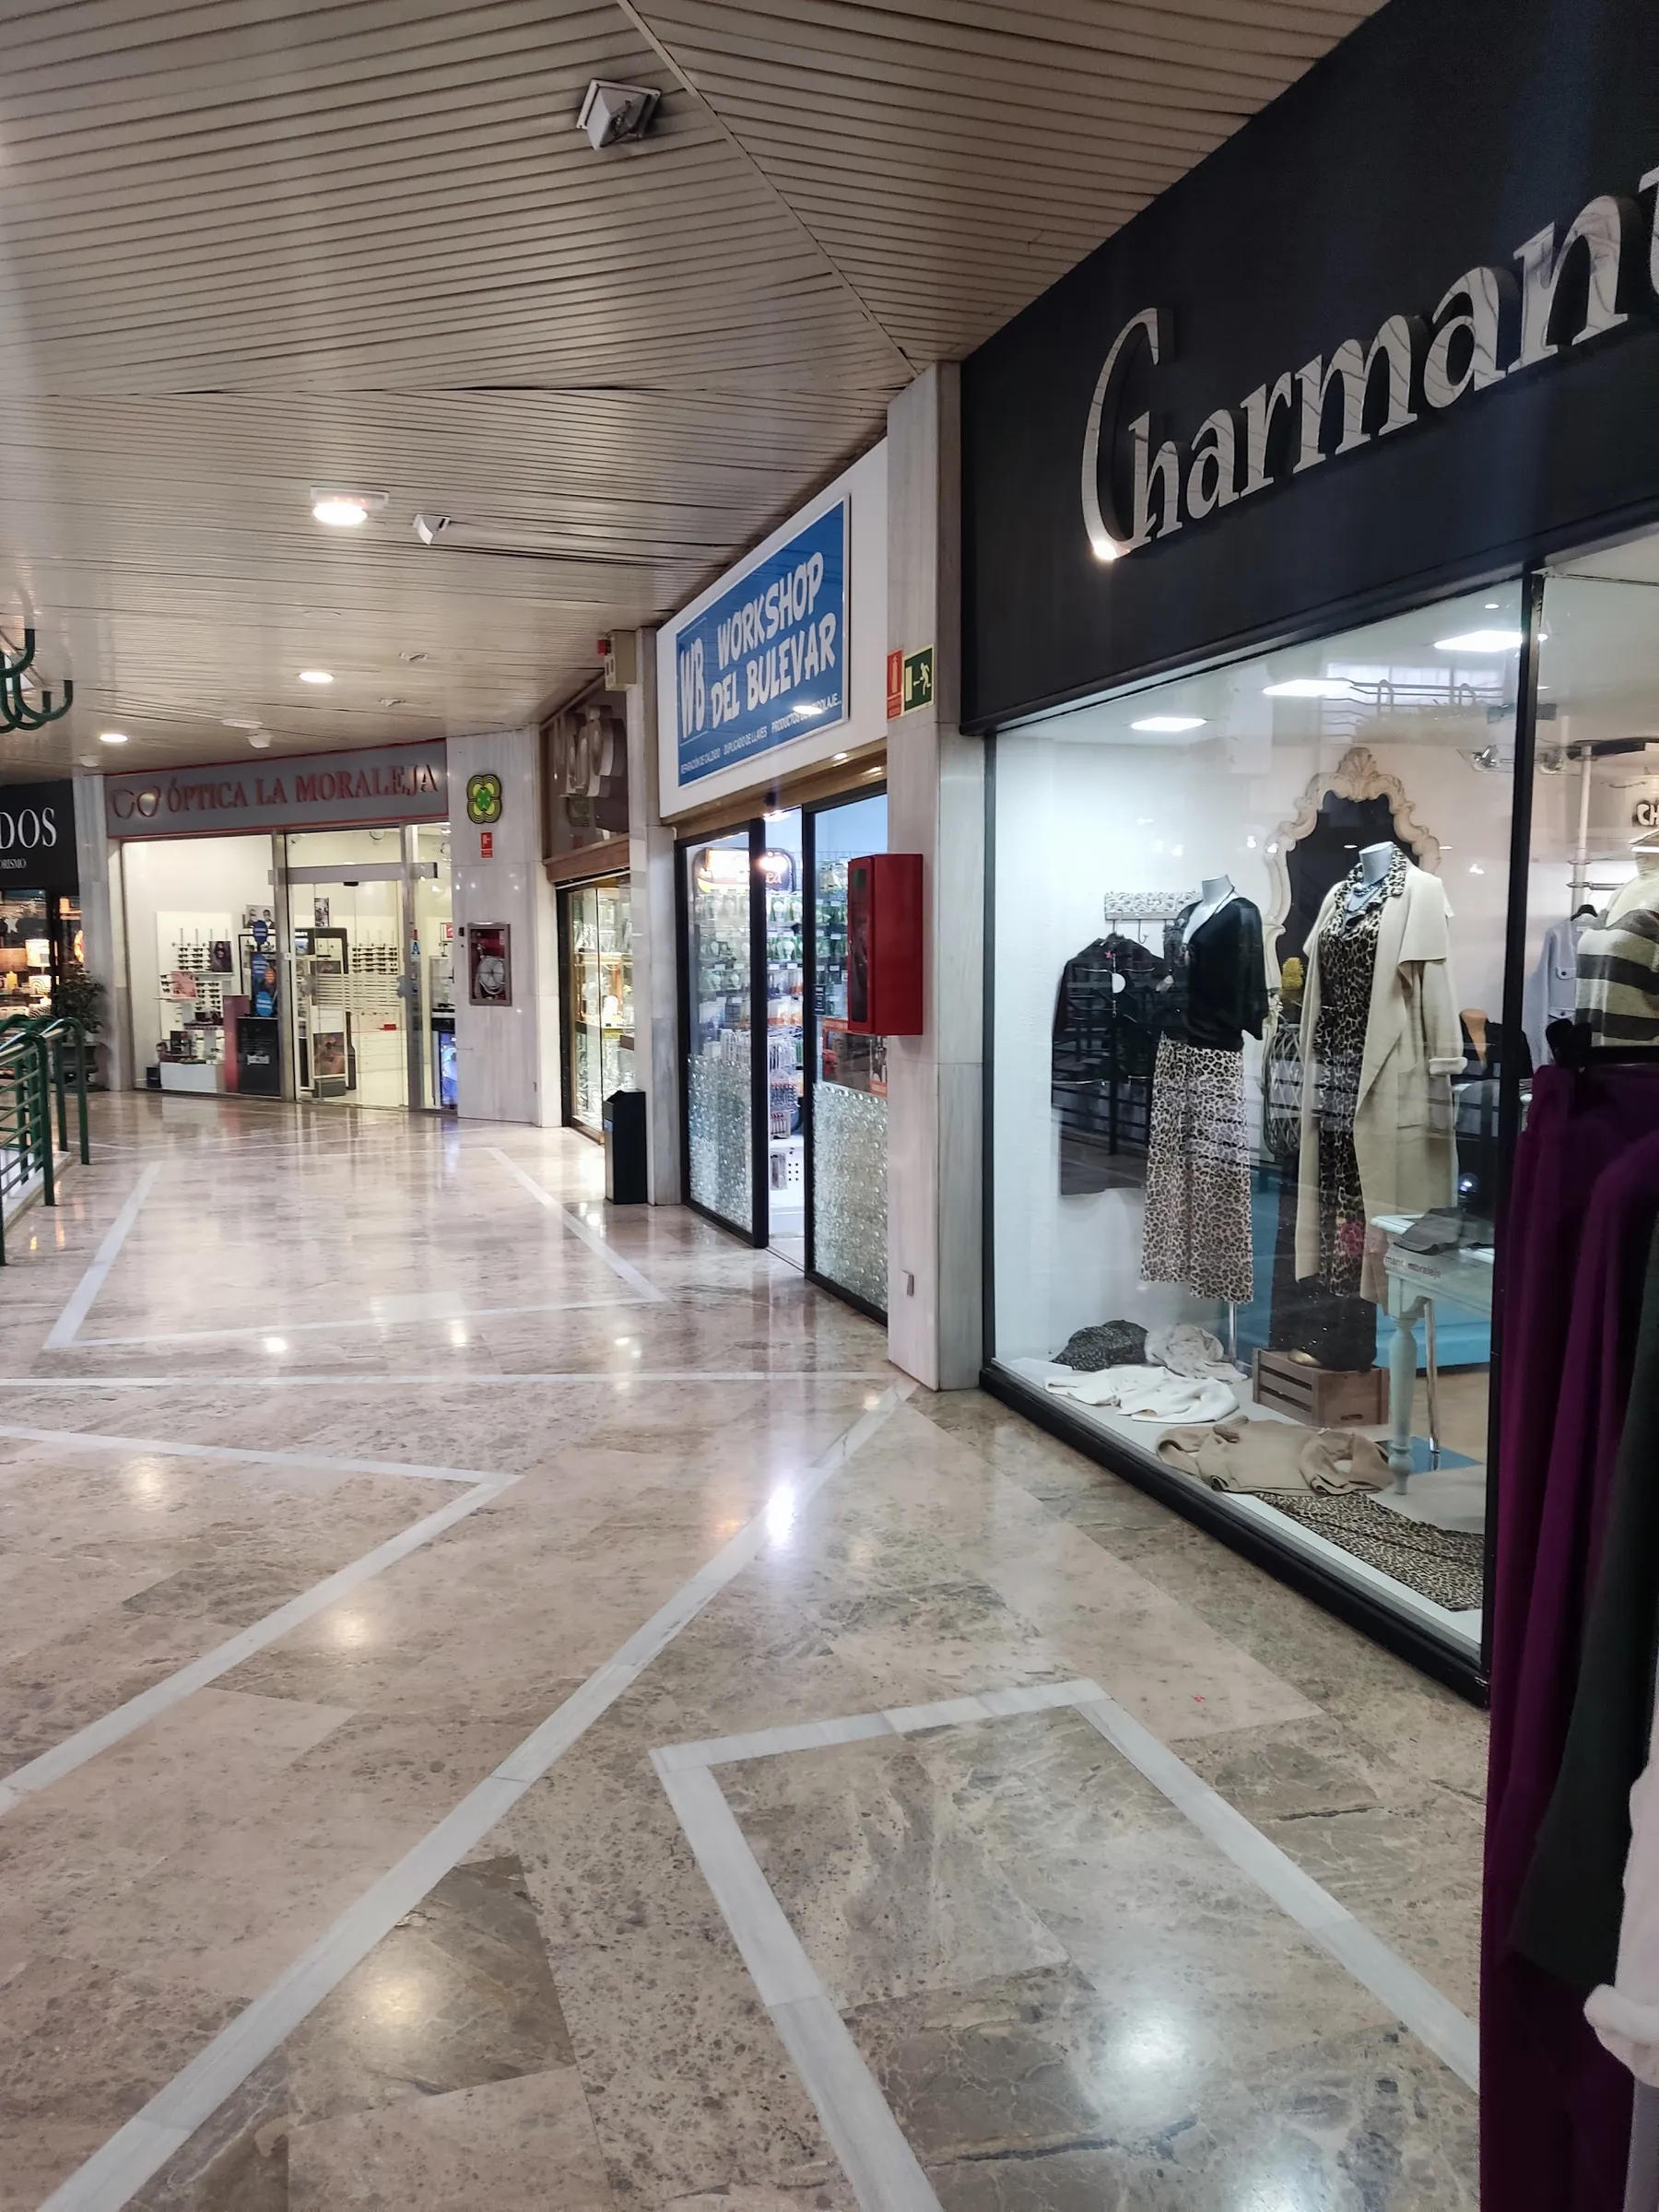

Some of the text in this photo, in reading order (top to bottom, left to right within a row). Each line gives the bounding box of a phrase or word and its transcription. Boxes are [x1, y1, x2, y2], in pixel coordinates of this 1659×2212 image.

[717, 551, 824, 671] WORKSHOP
[679, 637, 705, 739] WB
[711, 612, 836, 728] DEL BULEVAR
[167, 764, 440, 813] ÓPTICA LA MORALEJA
